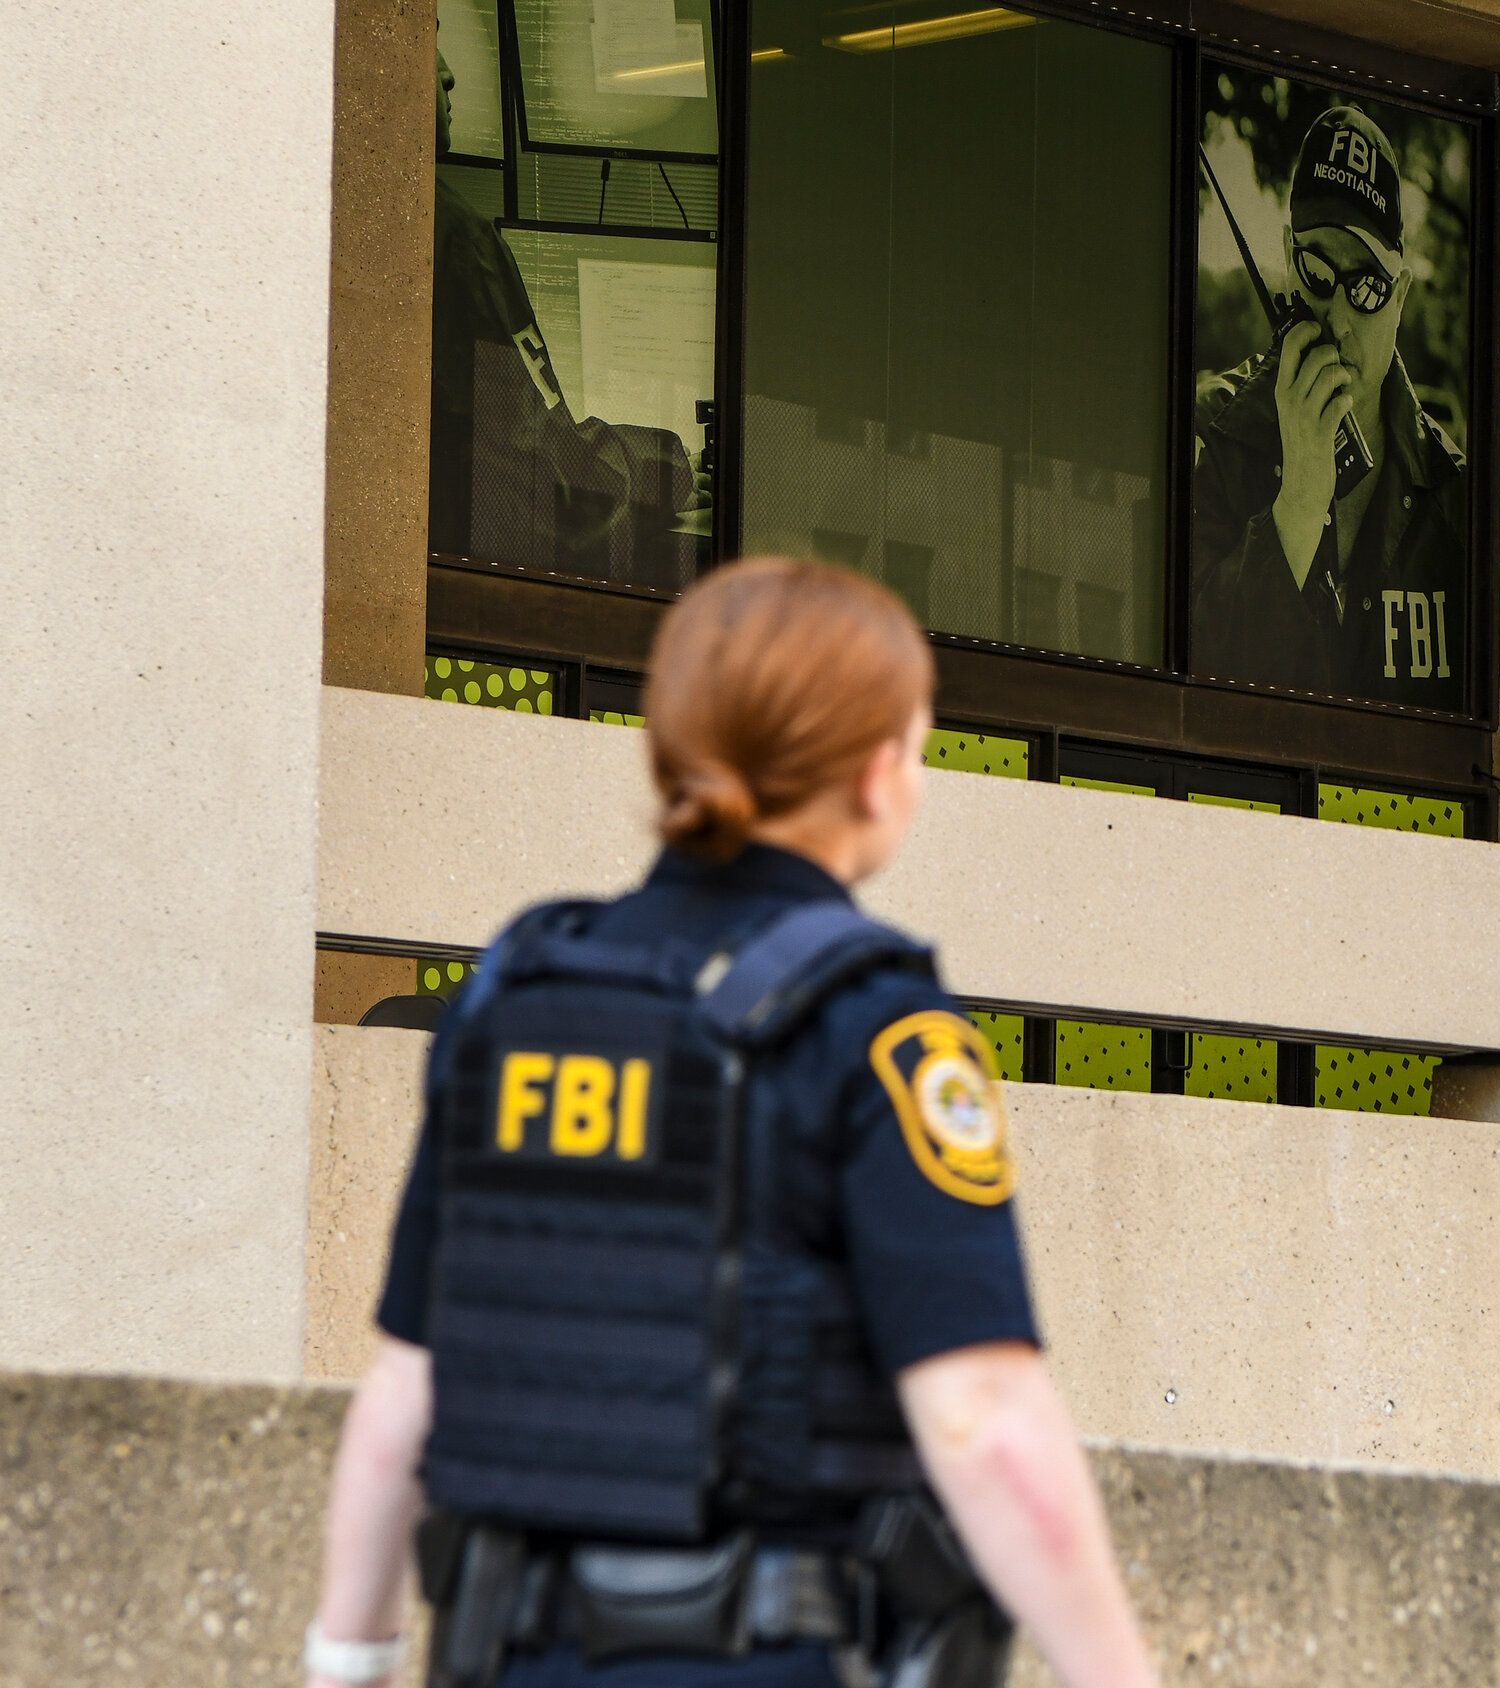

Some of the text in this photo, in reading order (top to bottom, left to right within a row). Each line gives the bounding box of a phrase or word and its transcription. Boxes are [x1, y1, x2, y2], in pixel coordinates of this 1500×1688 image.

[1313, 162, 1386, 214] NEGOTIATOR
[1328, 130, 1377, 184] FBI
[1381, 590, 1451, 678] FBI
[496, 1051, 653, 1162] FBI
